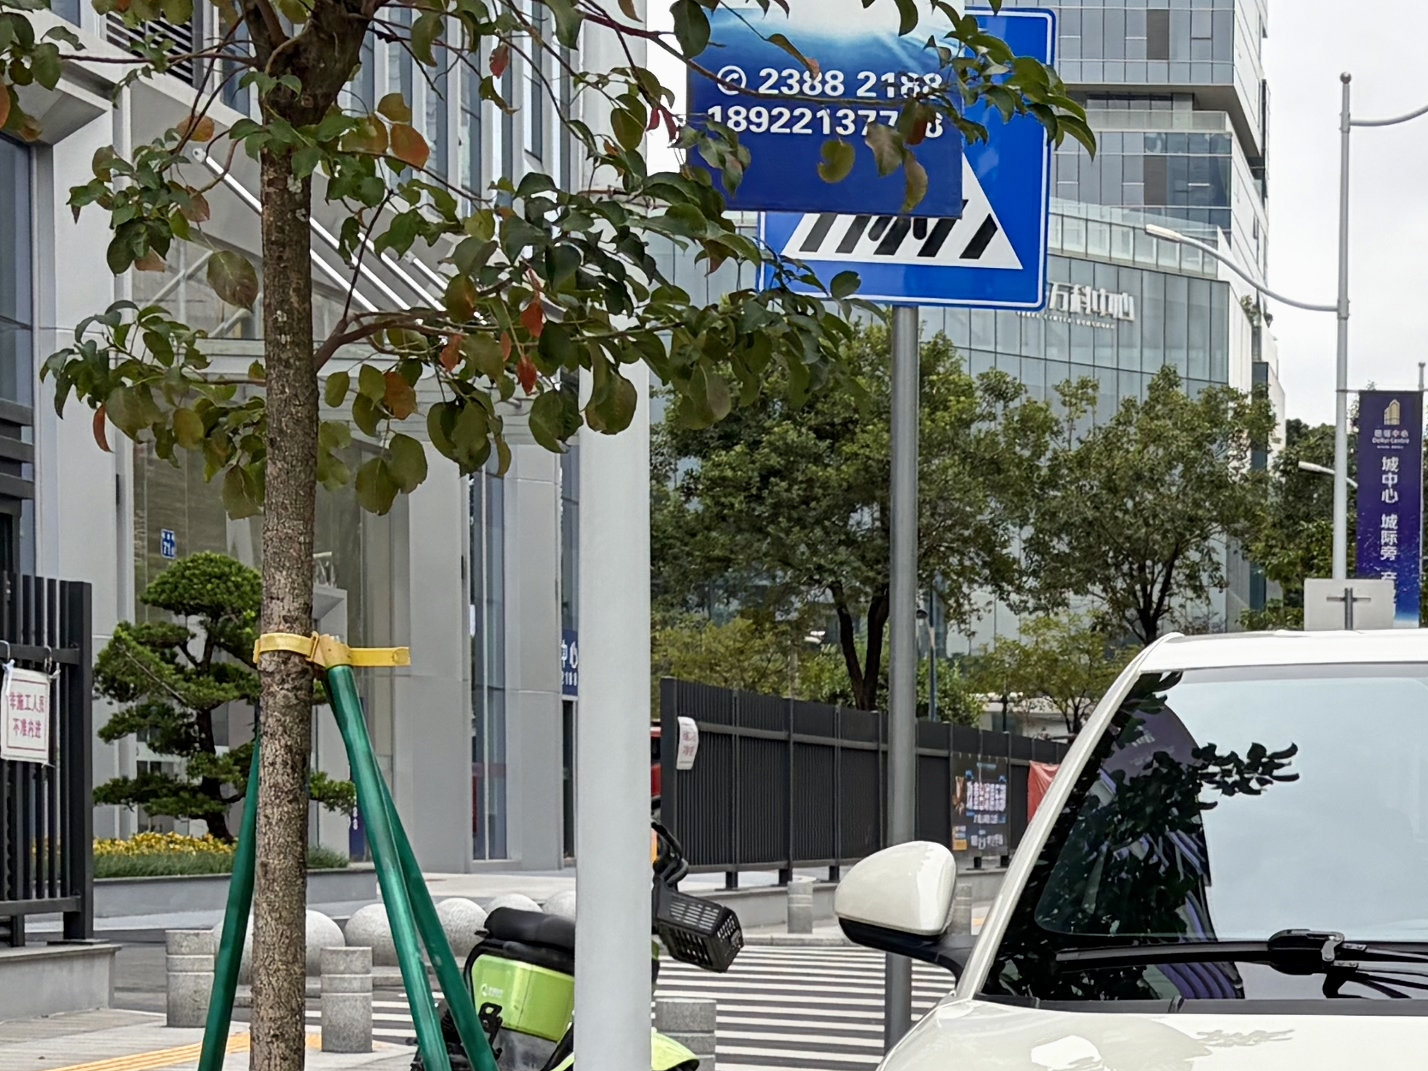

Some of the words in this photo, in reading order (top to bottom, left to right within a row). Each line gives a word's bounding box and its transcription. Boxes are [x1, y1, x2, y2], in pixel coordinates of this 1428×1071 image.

[758, 67, 845, 97] 2388
[855, 70, 944, 99] 2188
[706, 105, 945, 139] 1892213778
[1381, 456, 1399, 504] 城中心
[1380, 513, 1399, 561] 城际旁
